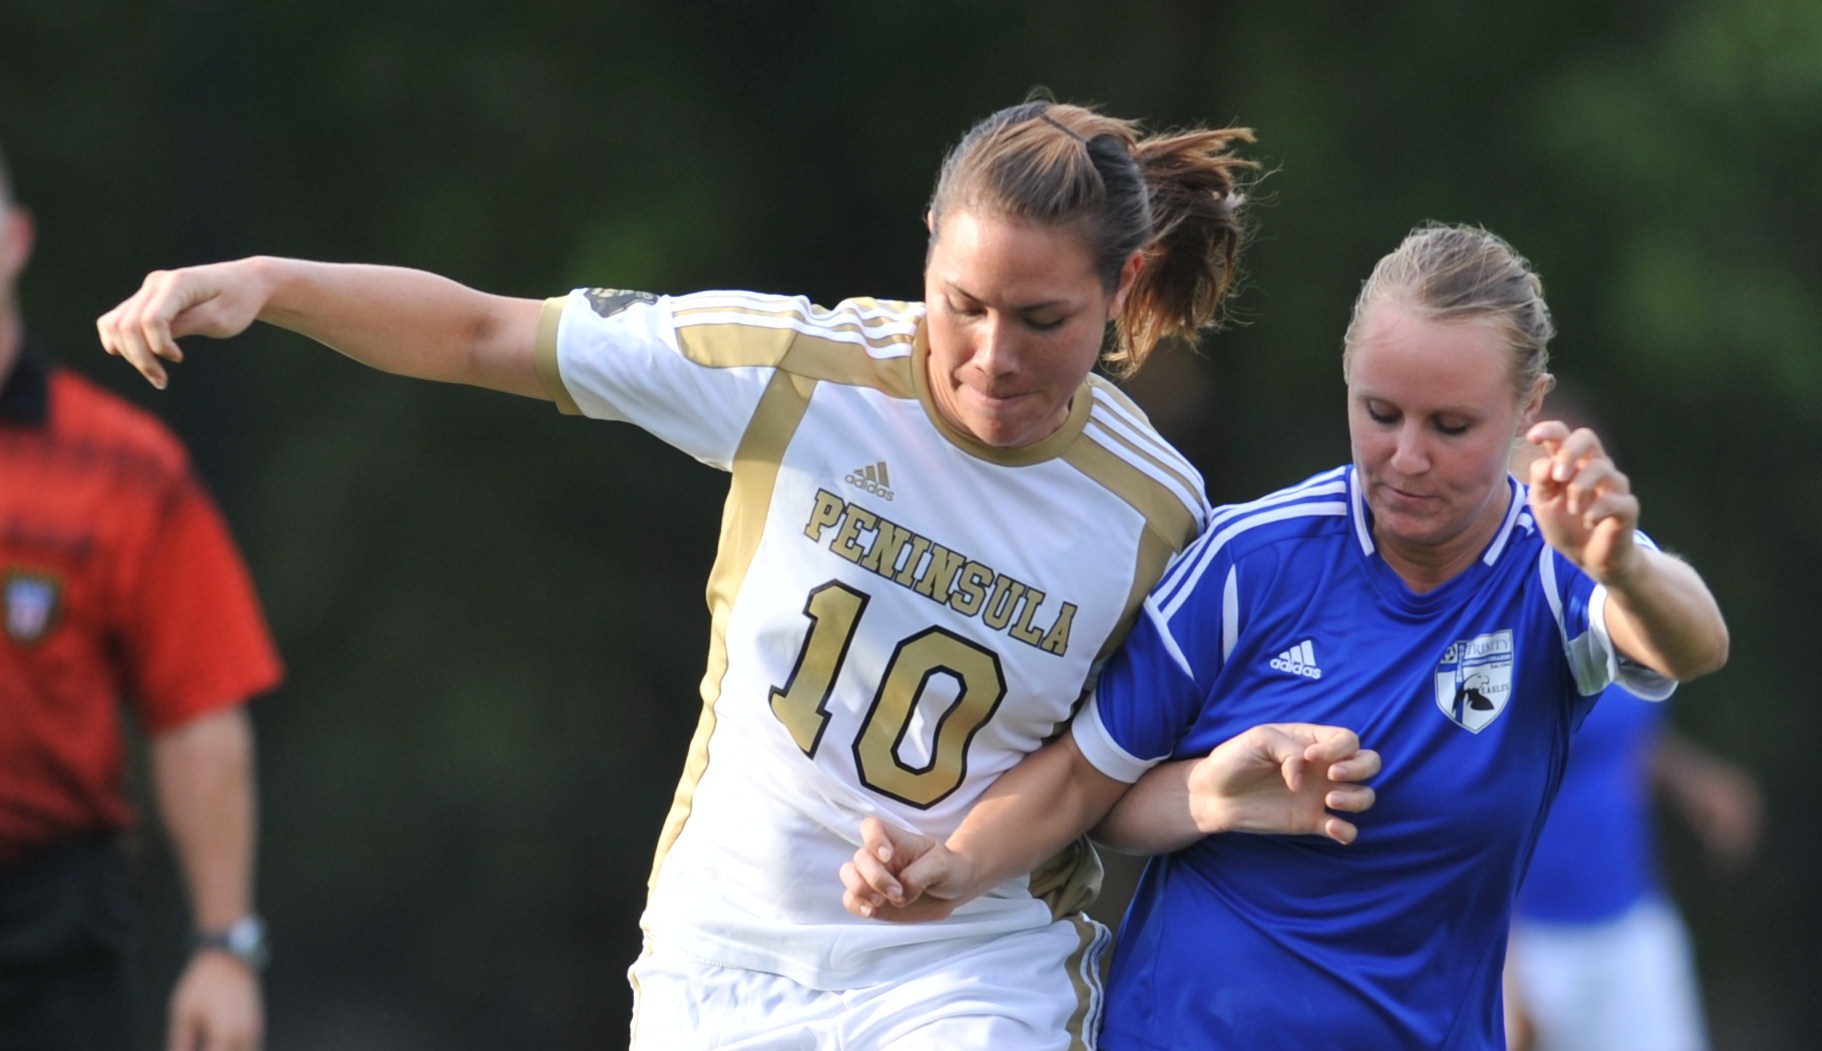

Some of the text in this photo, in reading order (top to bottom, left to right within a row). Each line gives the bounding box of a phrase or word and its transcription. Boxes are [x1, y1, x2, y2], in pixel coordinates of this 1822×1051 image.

[844, 473, 894, 501] adidas
[804, 488, 1078, 656] PENINSULA
[1467, 638, 1509, 655] TRINITY
[1269, 658, 1322, 680] adidas
[769, 579, 1007, 810] 10
